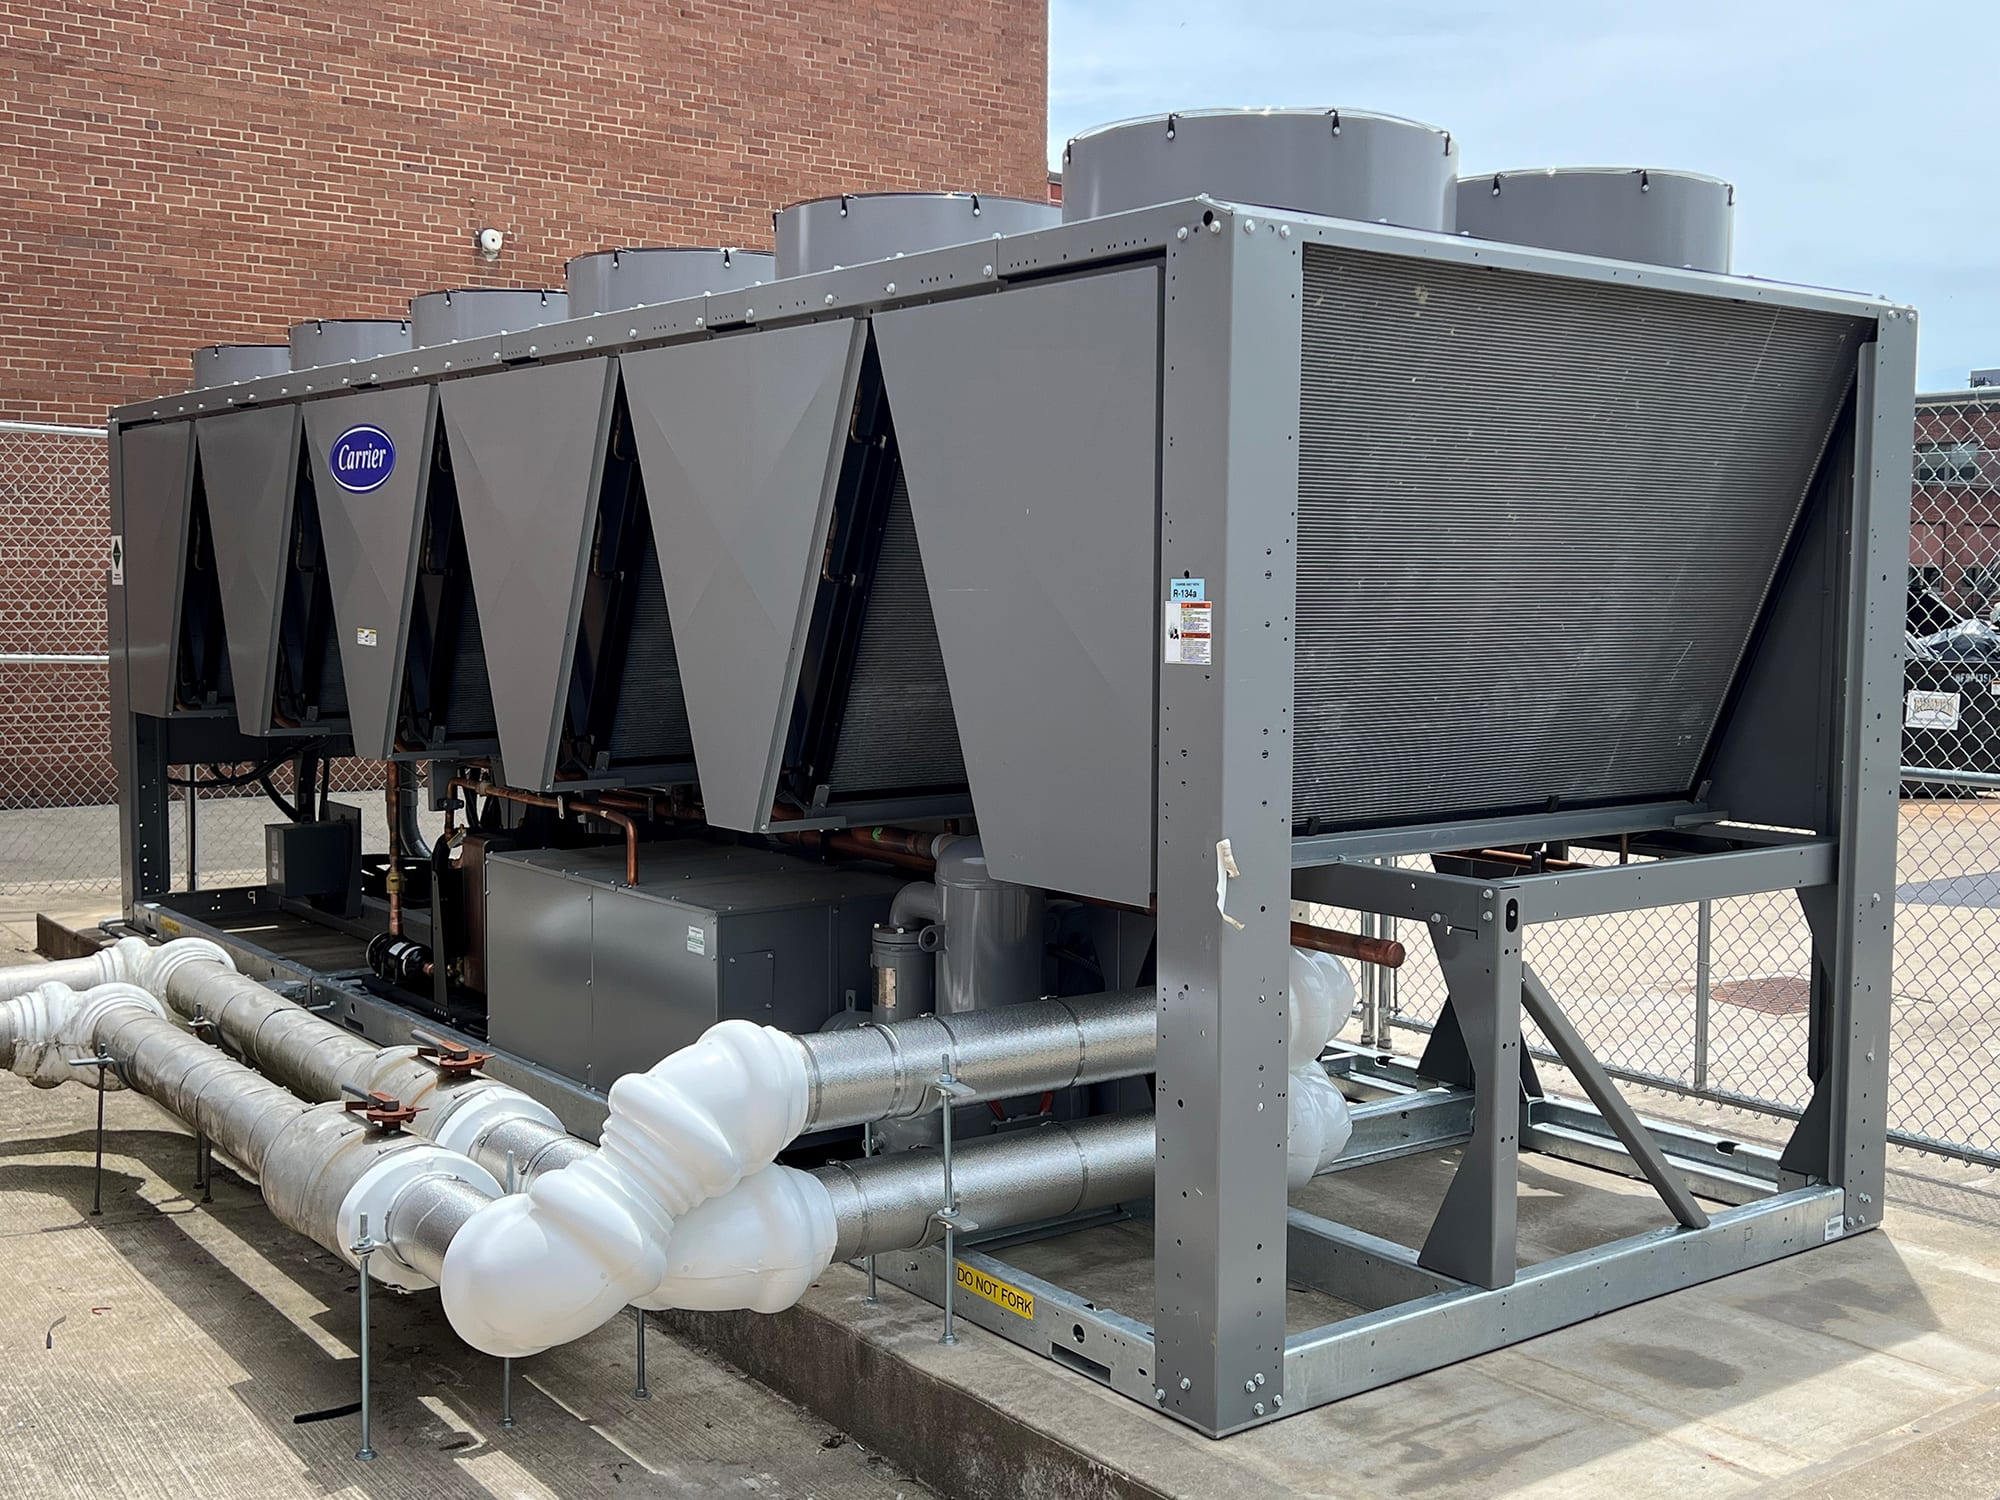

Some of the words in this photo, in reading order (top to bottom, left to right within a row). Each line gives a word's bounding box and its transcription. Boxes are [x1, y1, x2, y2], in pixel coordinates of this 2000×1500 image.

[338, 443, 386, 470] Carrier
[1173, 589, 1197, 598] R-134a
[957, 1267, 973, 1286] DO
[976, 1276, 998, 1298] NOT
[1001, 1288, 1032, 1315] FORK
